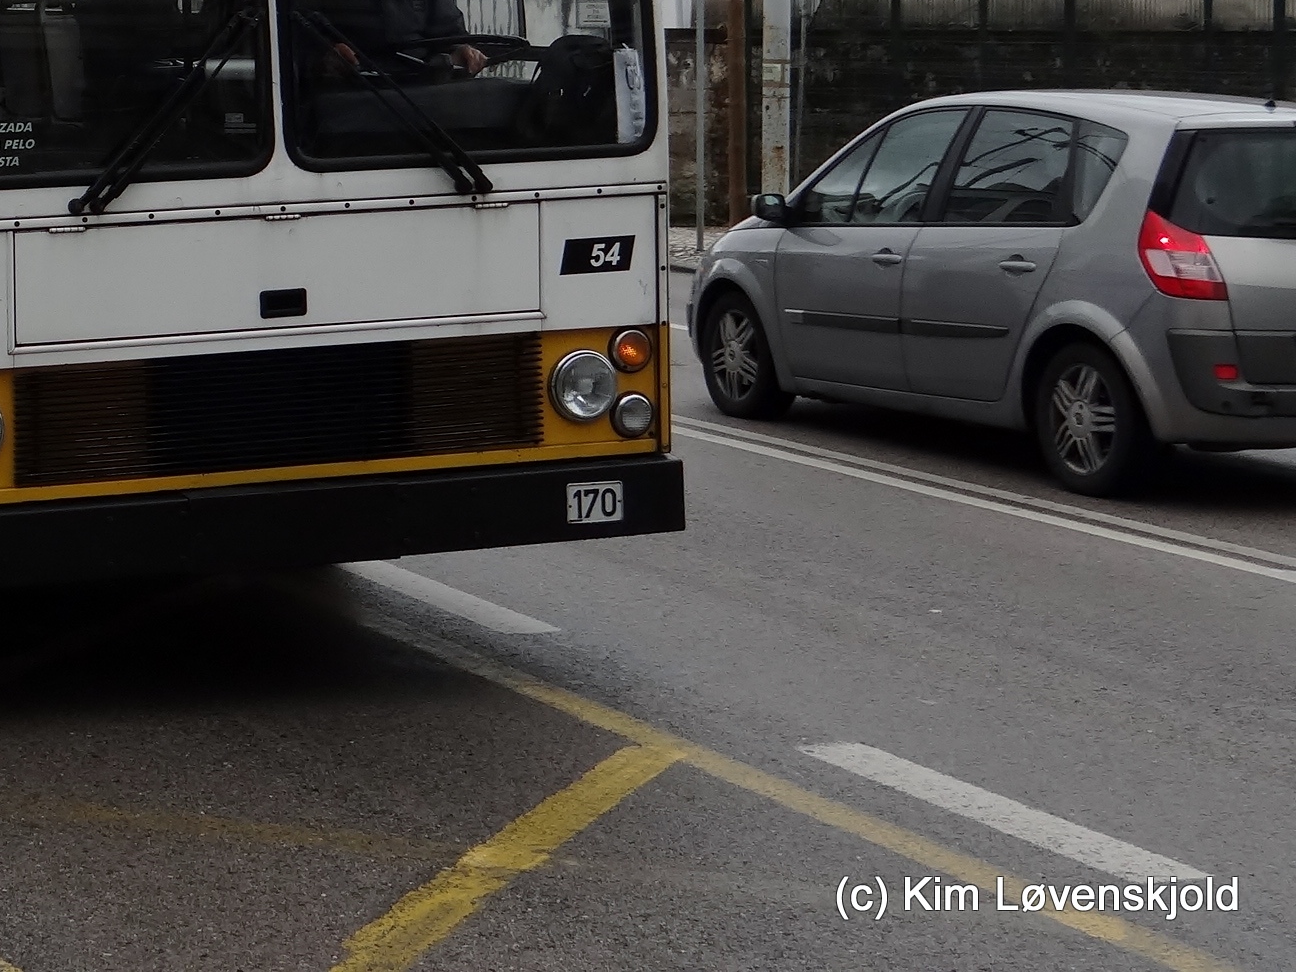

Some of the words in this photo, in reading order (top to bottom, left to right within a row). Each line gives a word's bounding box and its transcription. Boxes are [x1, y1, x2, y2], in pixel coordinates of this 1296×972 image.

[4, 138, 36, 151] PELO
[590, 242, 621, 267] 54
[572, 487, 617, 520] 170
